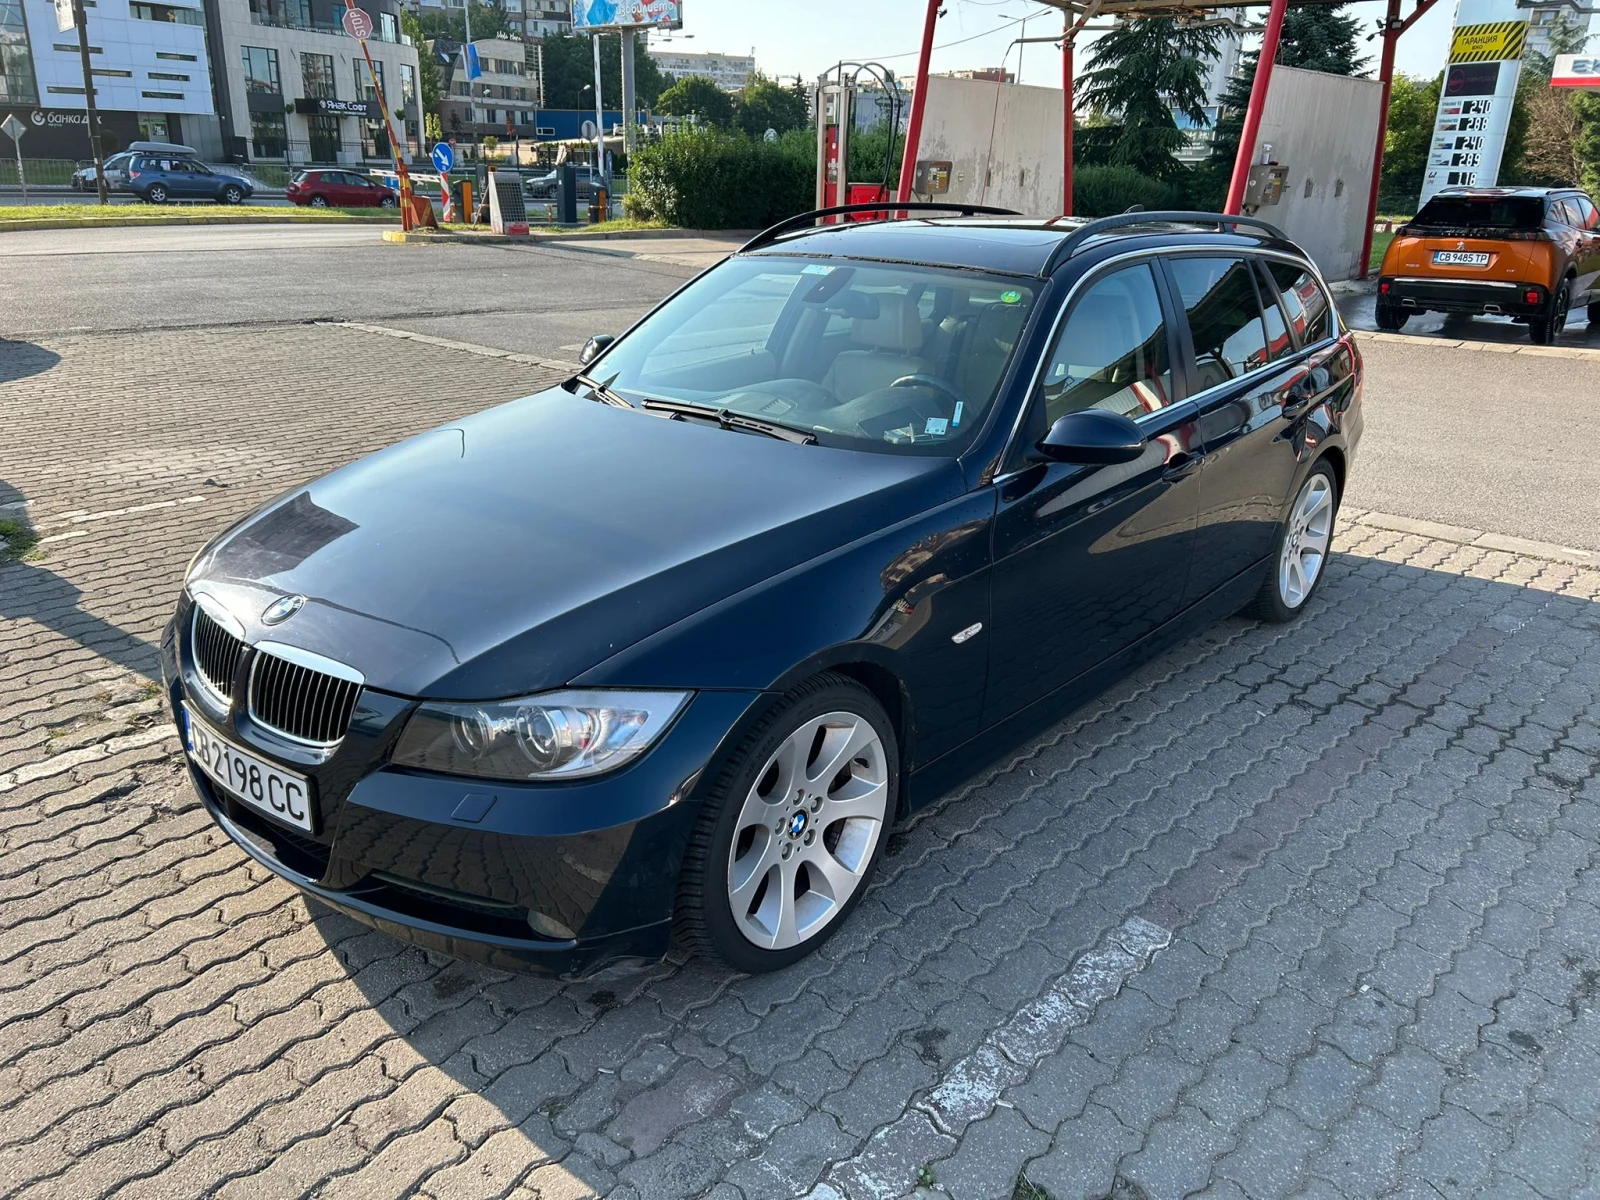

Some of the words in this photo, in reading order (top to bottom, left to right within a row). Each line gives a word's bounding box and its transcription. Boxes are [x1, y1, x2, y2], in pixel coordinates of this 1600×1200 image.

[350, 11, 366, 37] STOP
[1462, 35, 1498, 46] ГАРАНЦИЯ
[347, 102, 367, 111] Софт
[47, 111, 80, 124] банка
